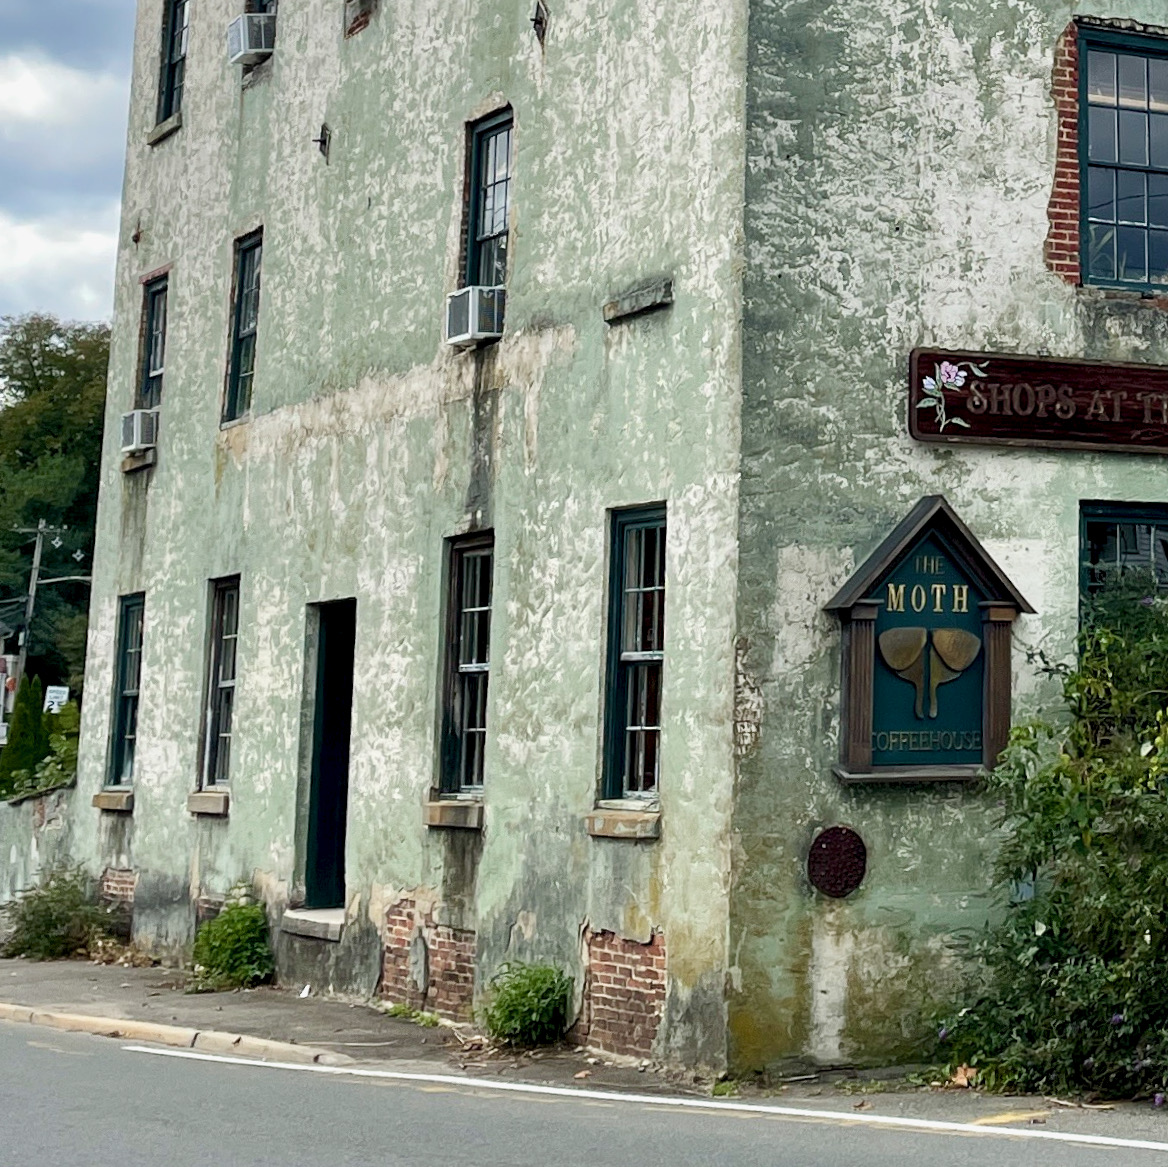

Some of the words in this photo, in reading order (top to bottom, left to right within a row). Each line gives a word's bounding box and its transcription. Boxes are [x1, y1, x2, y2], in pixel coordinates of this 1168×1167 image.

[966, 379, 1077, 420] SHOPS
[1085, 389, 1128, 423] AT
[914, 555, 946, 575] THE
[886, 583, 969, 613] MOTH
